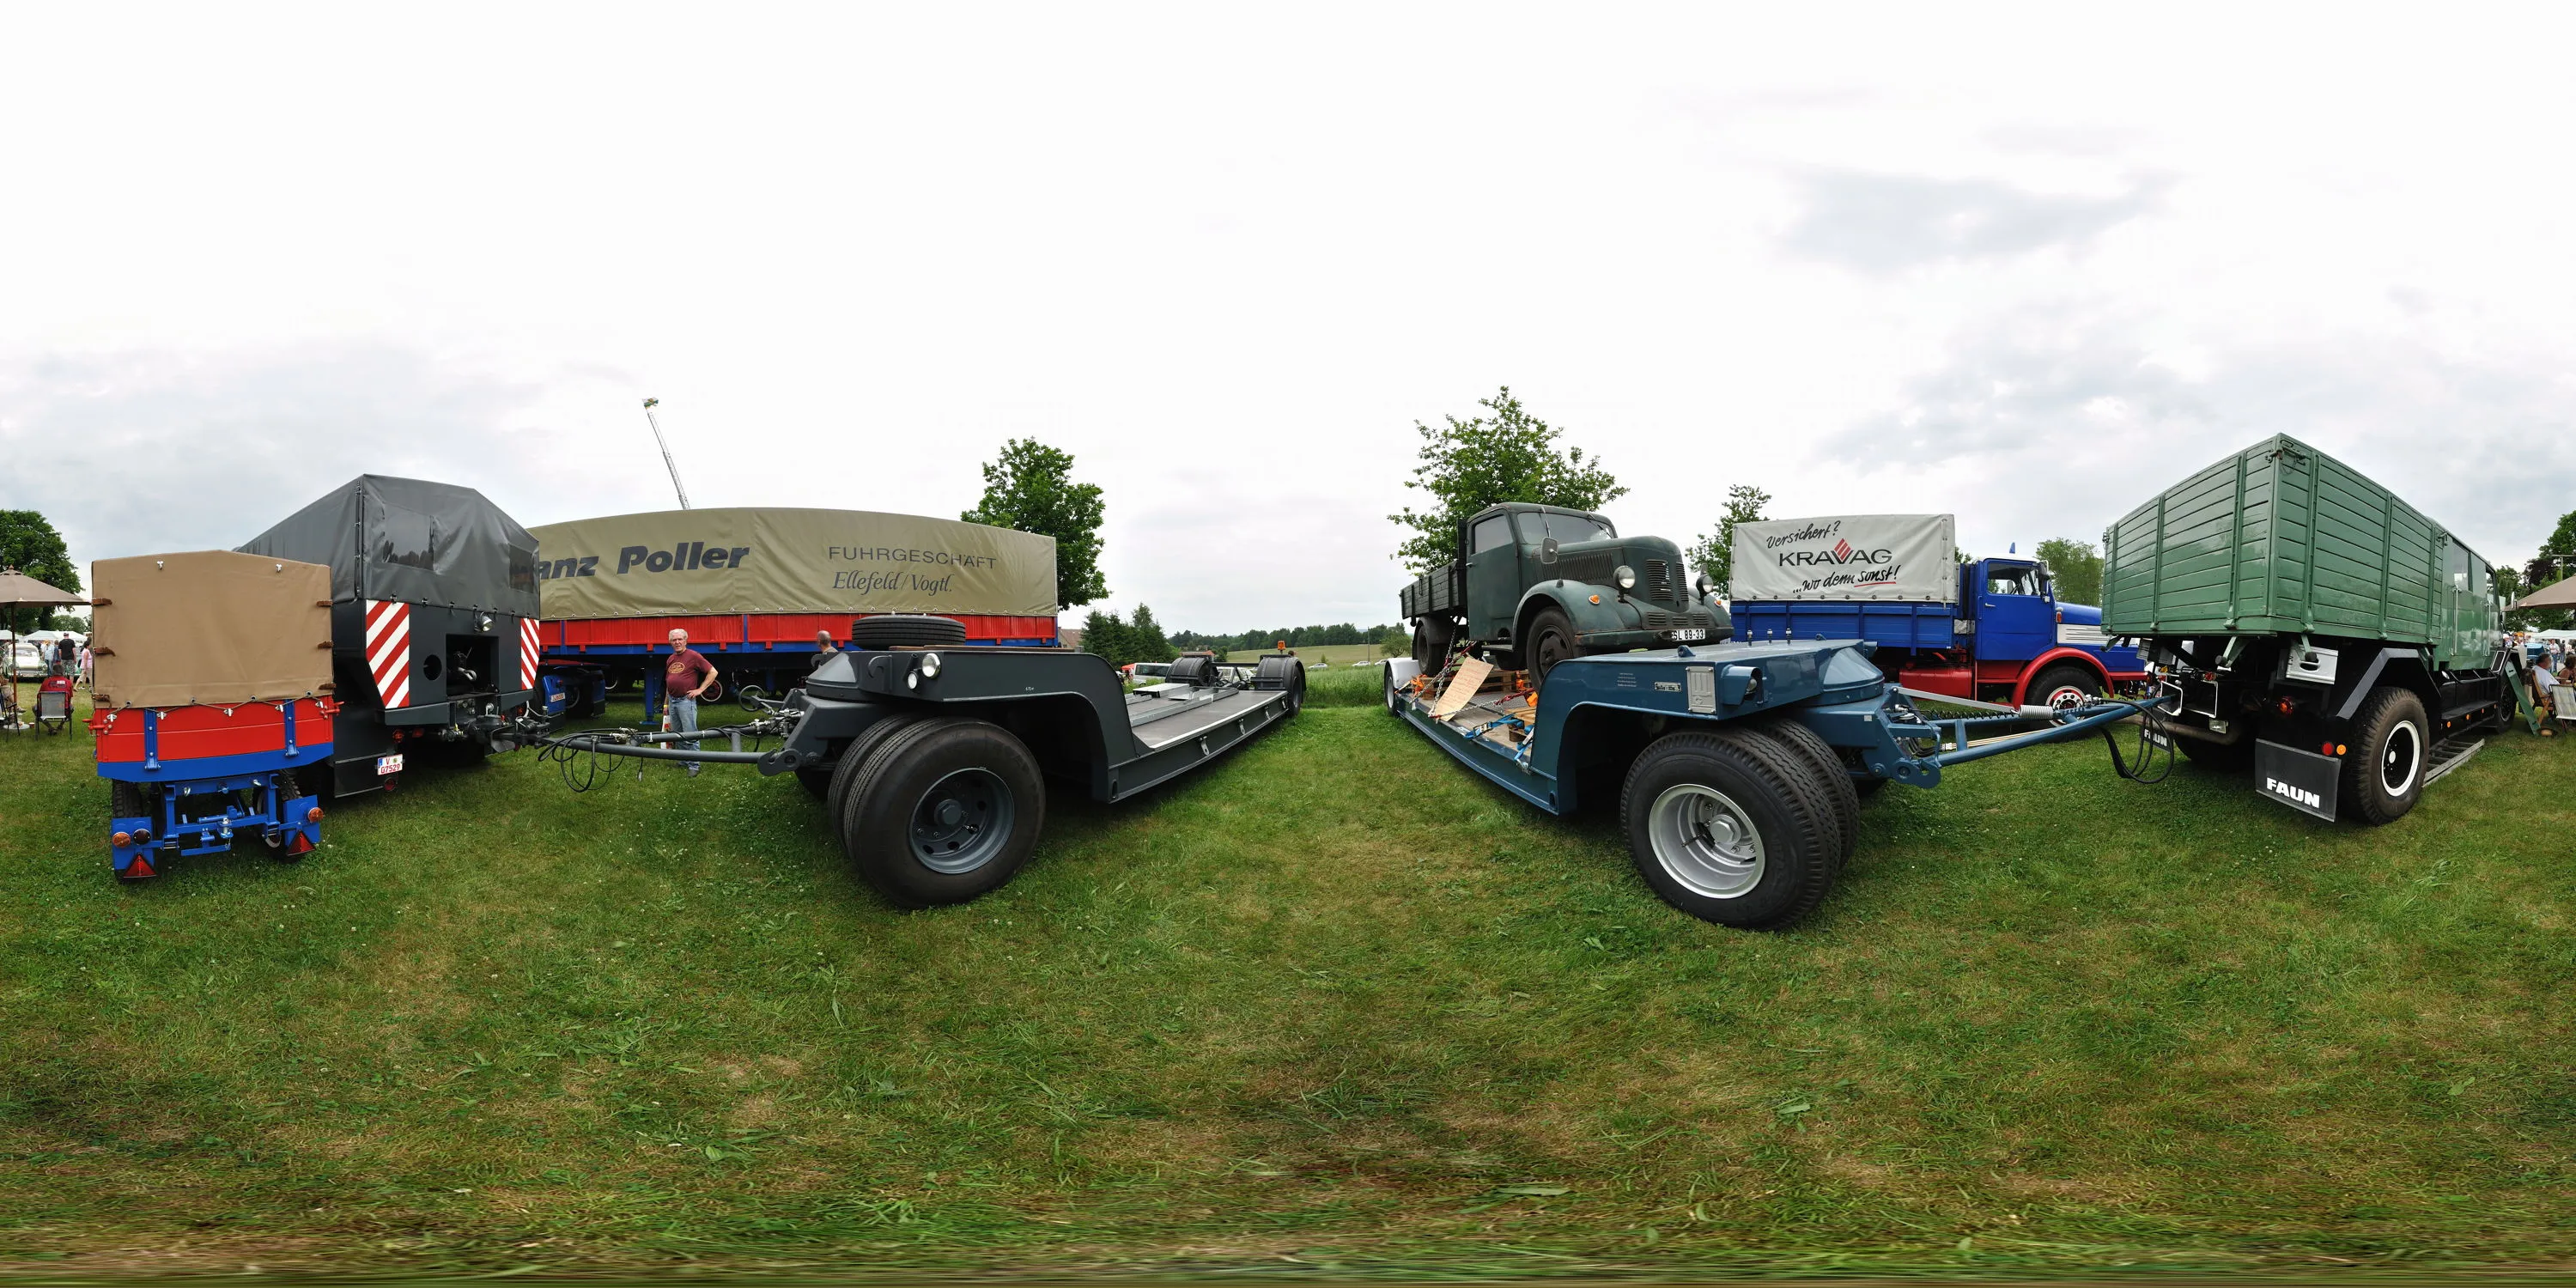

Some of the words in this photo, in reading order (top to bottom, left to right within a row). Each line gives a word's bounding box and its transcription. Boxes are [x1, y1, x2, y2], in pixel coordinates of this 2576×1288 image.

[539, 556, 599, 580] anz
[617, 541, 750, 574] Poller
[829, 546, 997, 569] FUHRGESCHÄFT
[1779, 549, 1893, 567] KRAVAG
[1823, 571, 1855, 587] denn
[1857, 564, 1901, 583] sonst!
[2267, 777, 2320, 809] FAUN
